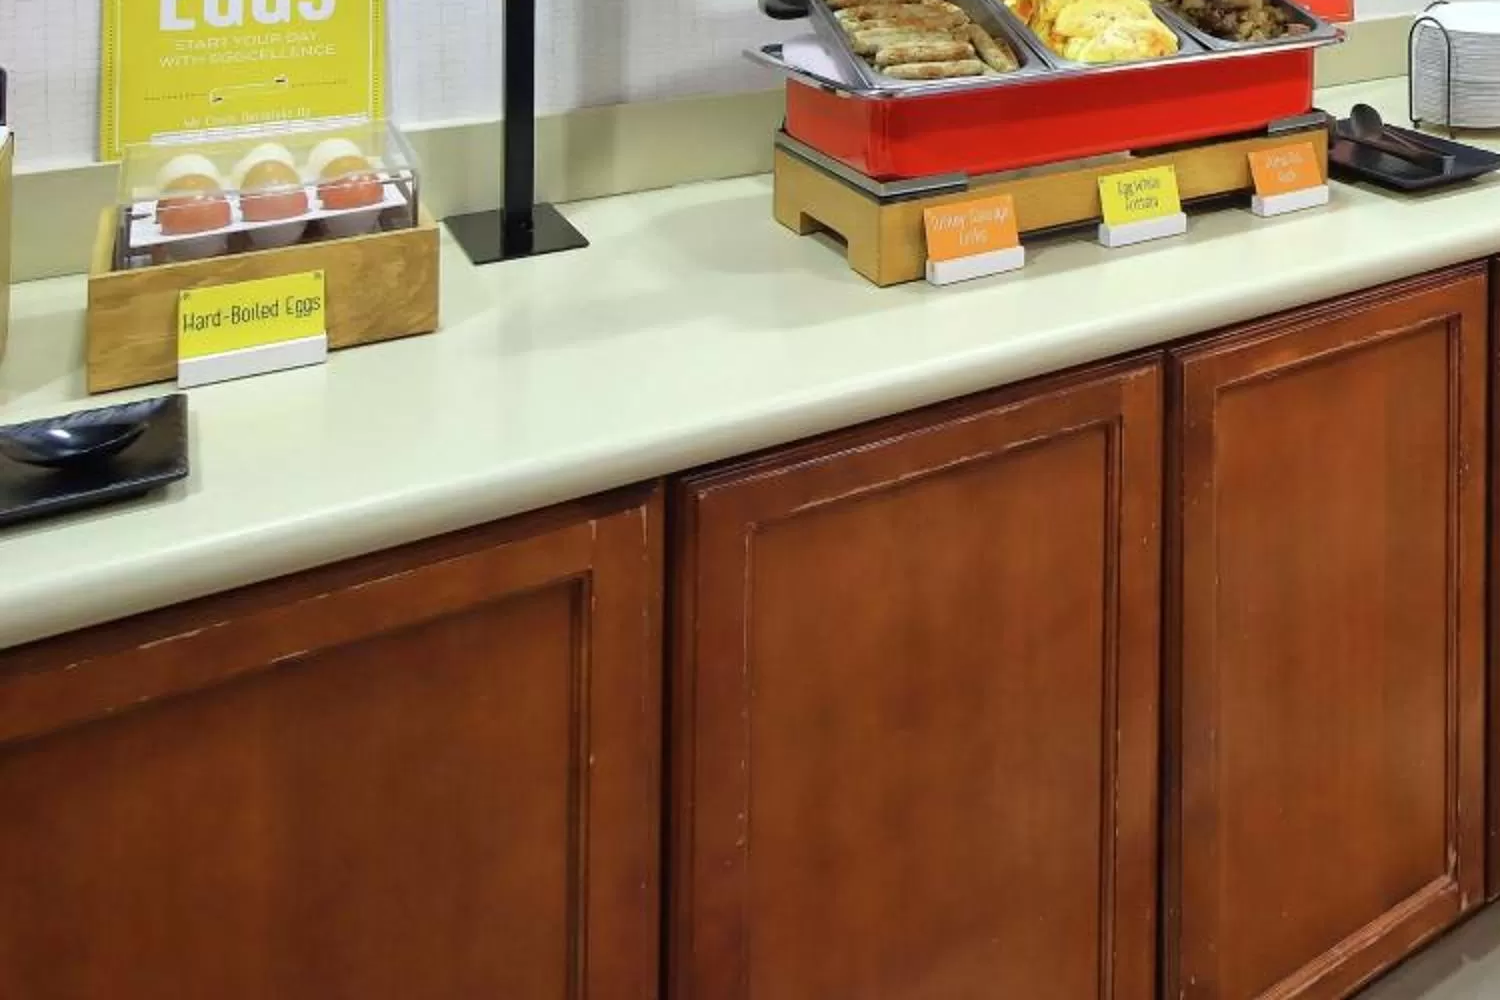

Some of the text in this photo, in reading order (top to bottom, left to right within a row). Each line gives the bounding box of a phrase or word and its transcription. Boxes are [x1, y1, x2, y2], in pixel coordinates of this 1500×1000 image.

[176, 36, 228, 51] START
[231, 32, 282, 47] YOUR
[159, 54, 206, 69] WITH
[182, 295, 321, 333] Hard-Boiled Eggs
